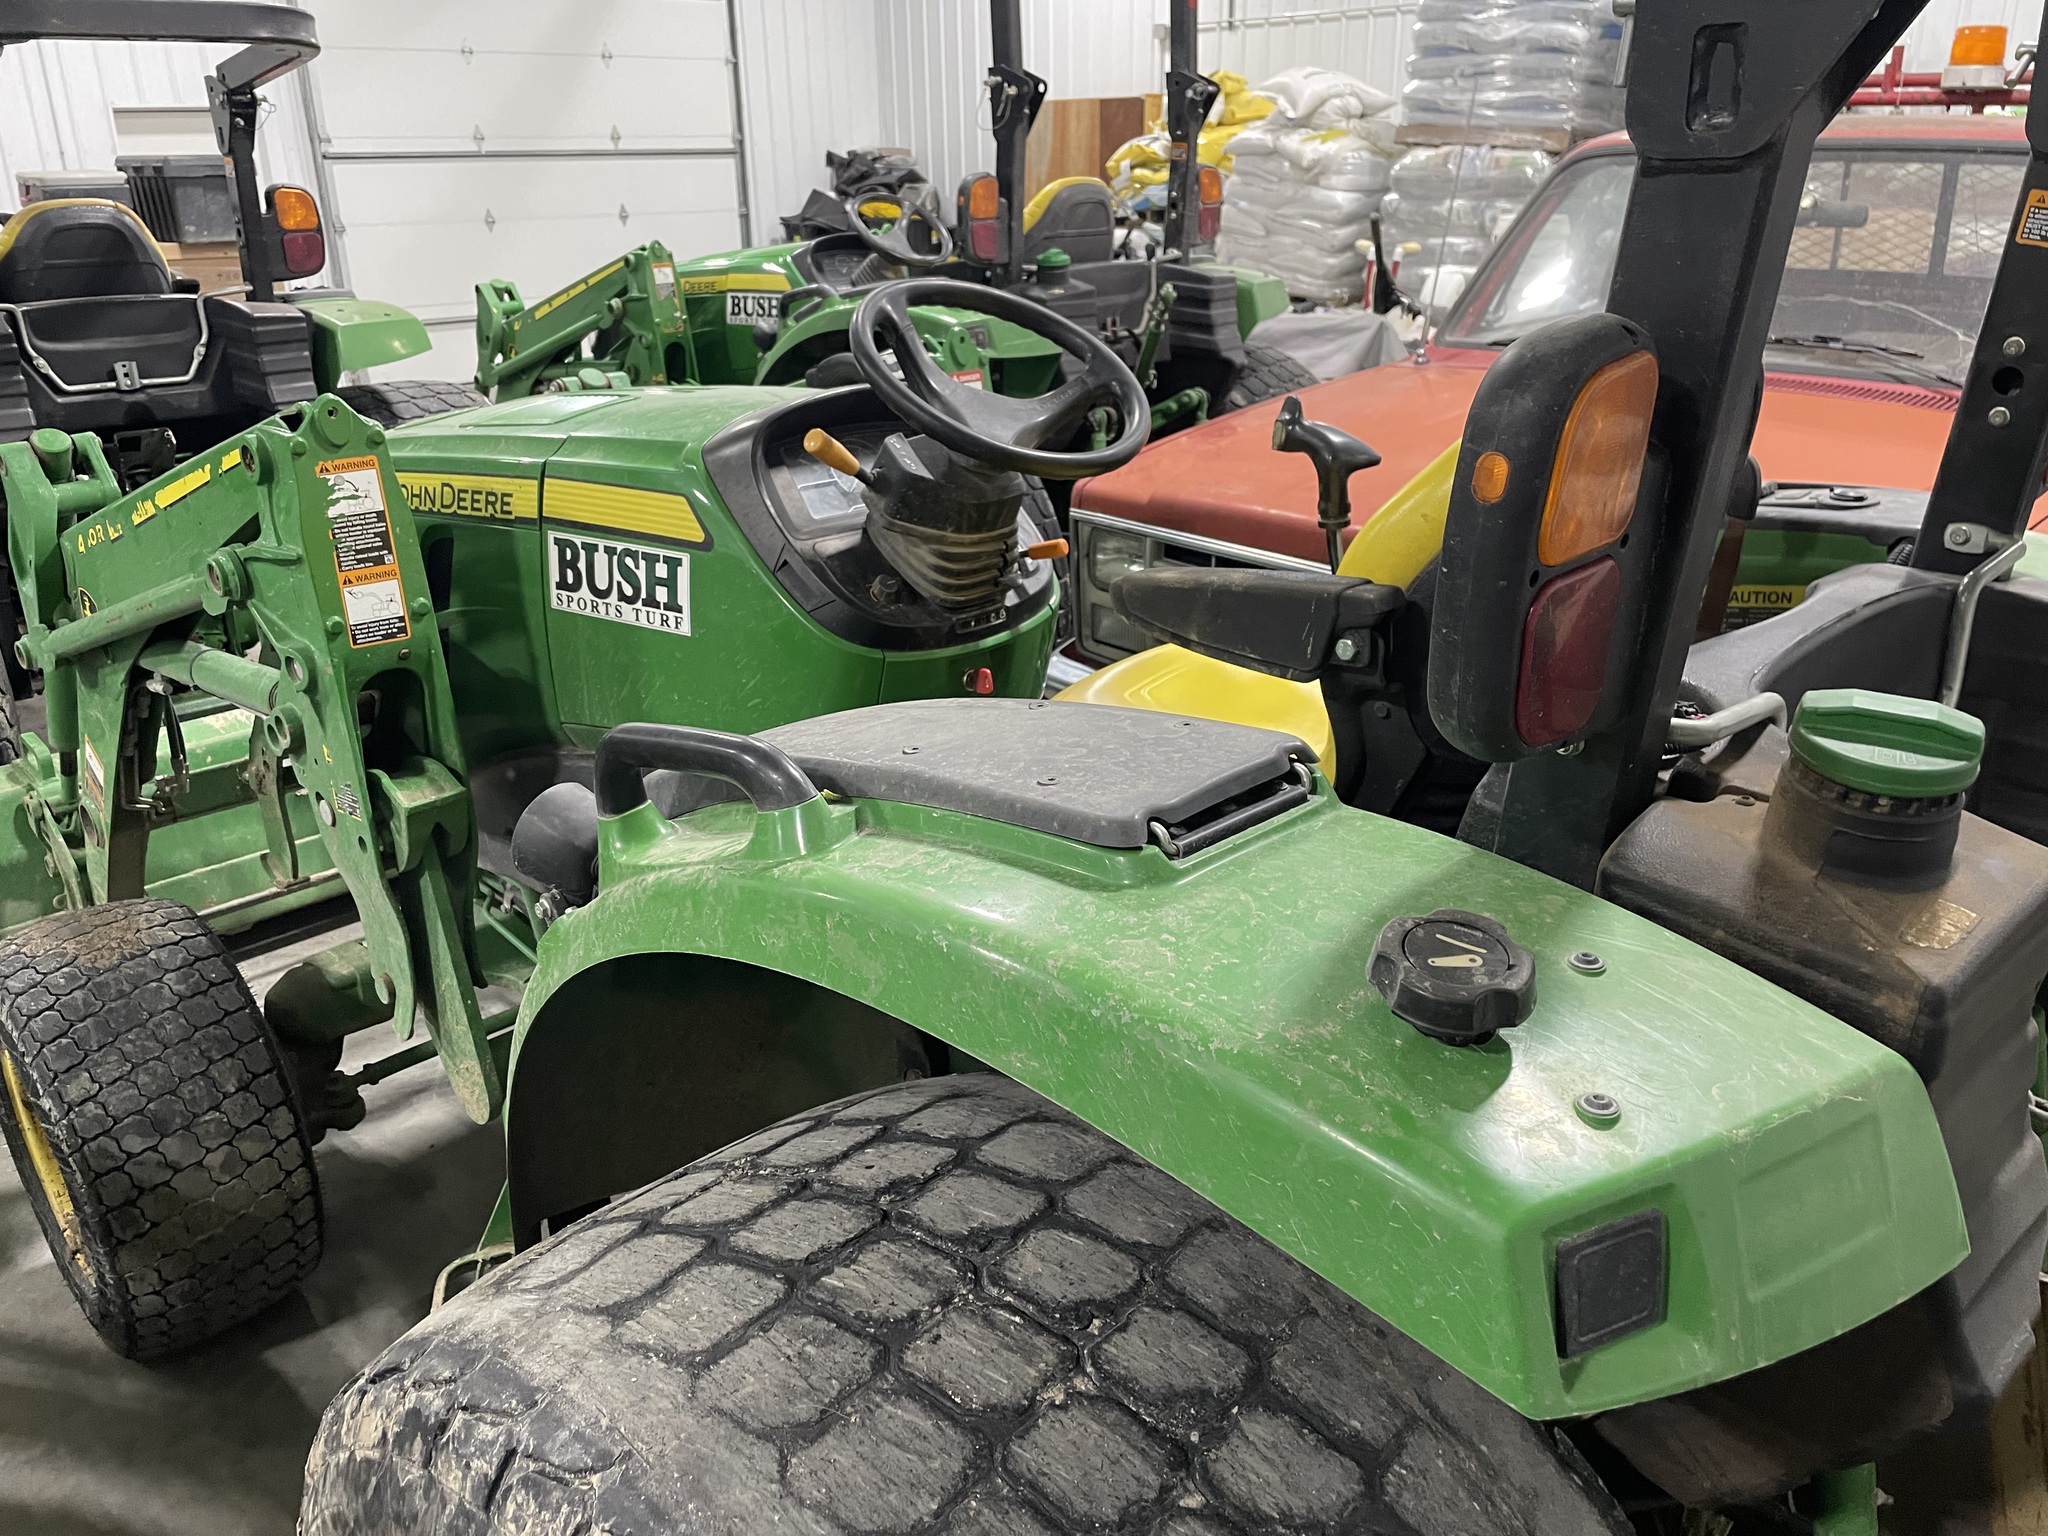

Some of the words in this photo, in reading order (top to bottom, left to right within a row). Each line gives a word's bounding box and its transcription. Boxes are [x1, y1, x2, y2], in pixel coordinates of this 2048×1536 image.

[731, 295, 779, 318] BUSH
[332, 459, 375, 472] WARNING
[400, 483, 436, 508] OHN
[441, 482, 514, 516] DEERE
[355, 570, 397, 583] WARNING
[553, 536, 683, 614] BUSH
[1730, 591, 1793, 605] AUTION
[556, 592, 623, 619] SPORTS
[632, 607, 684, 630] TURF
